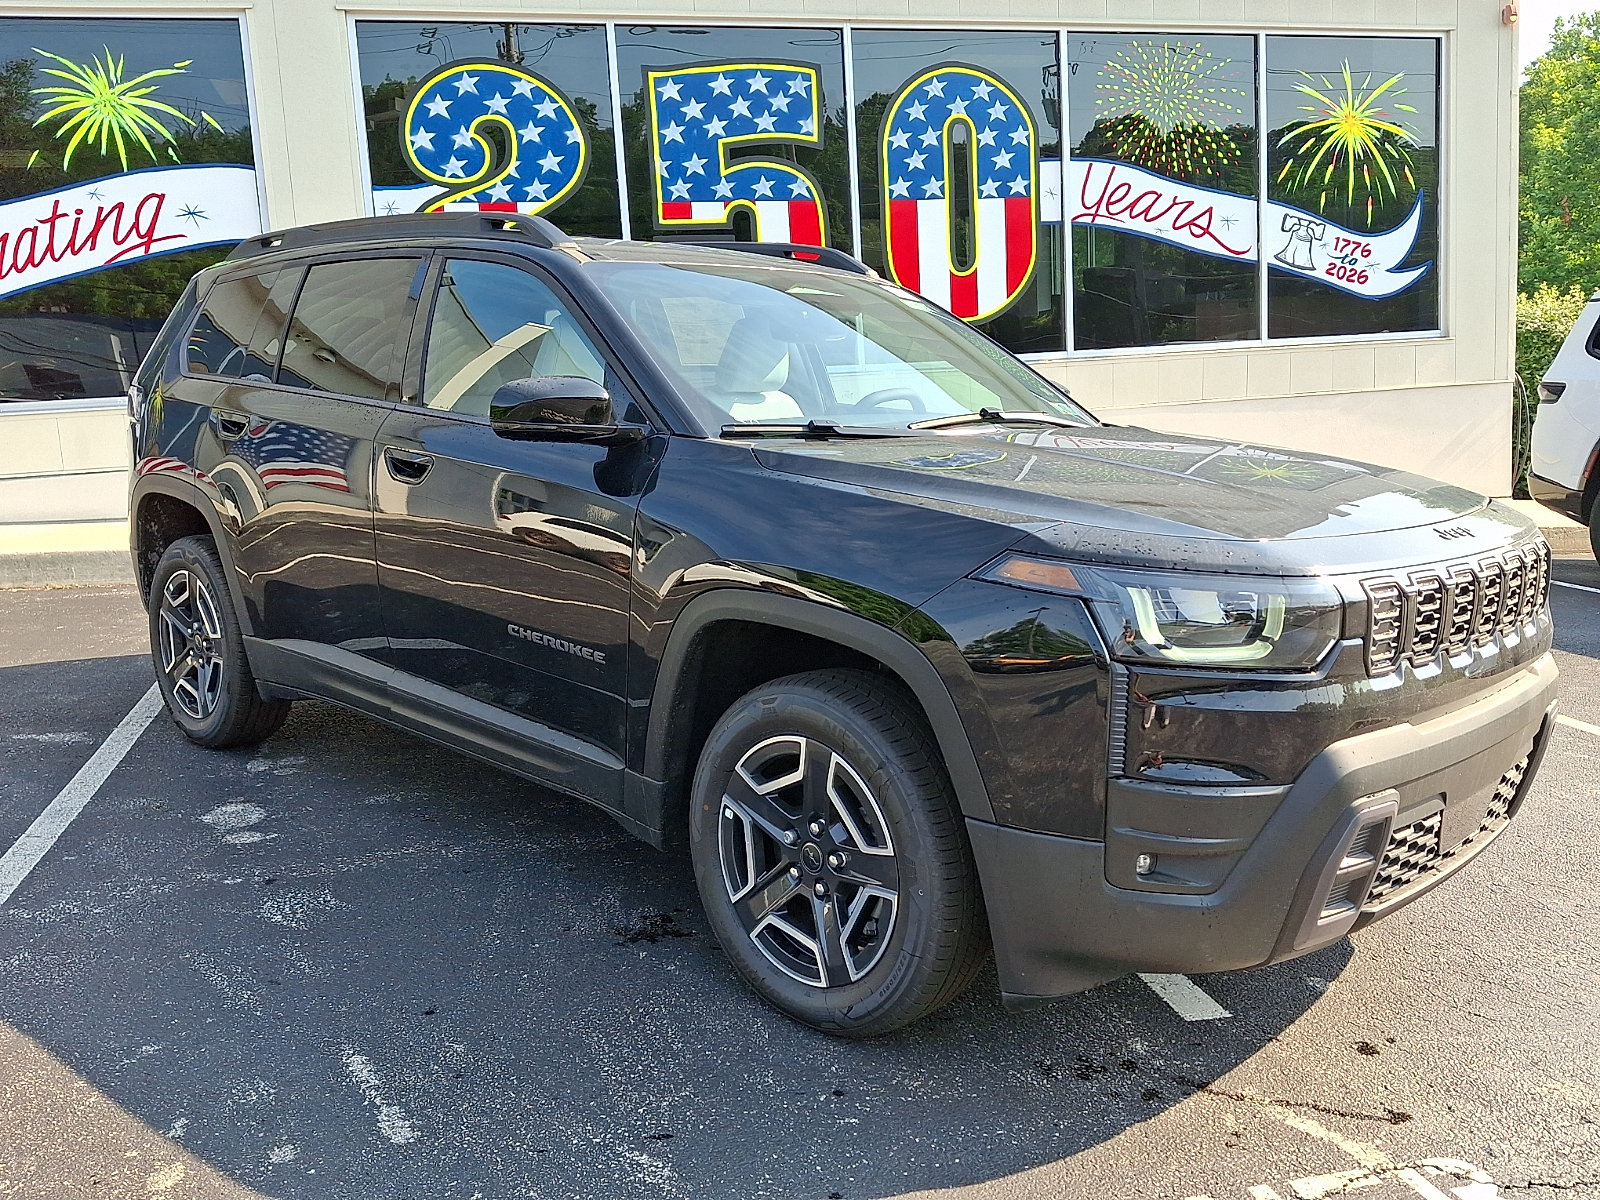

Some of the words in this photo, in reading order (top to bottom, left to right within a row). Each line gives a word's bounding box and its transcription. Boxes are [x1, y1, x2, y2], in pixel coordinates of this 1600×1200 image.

[404, 60, 1037, 324] 250
[1071, 163, 1252, 255] Years
[1334, 236, 1372, 258] 1776
[1325, 262, 1369, 285] 2026
[506, 623, 606, 665] CHEROKEE
